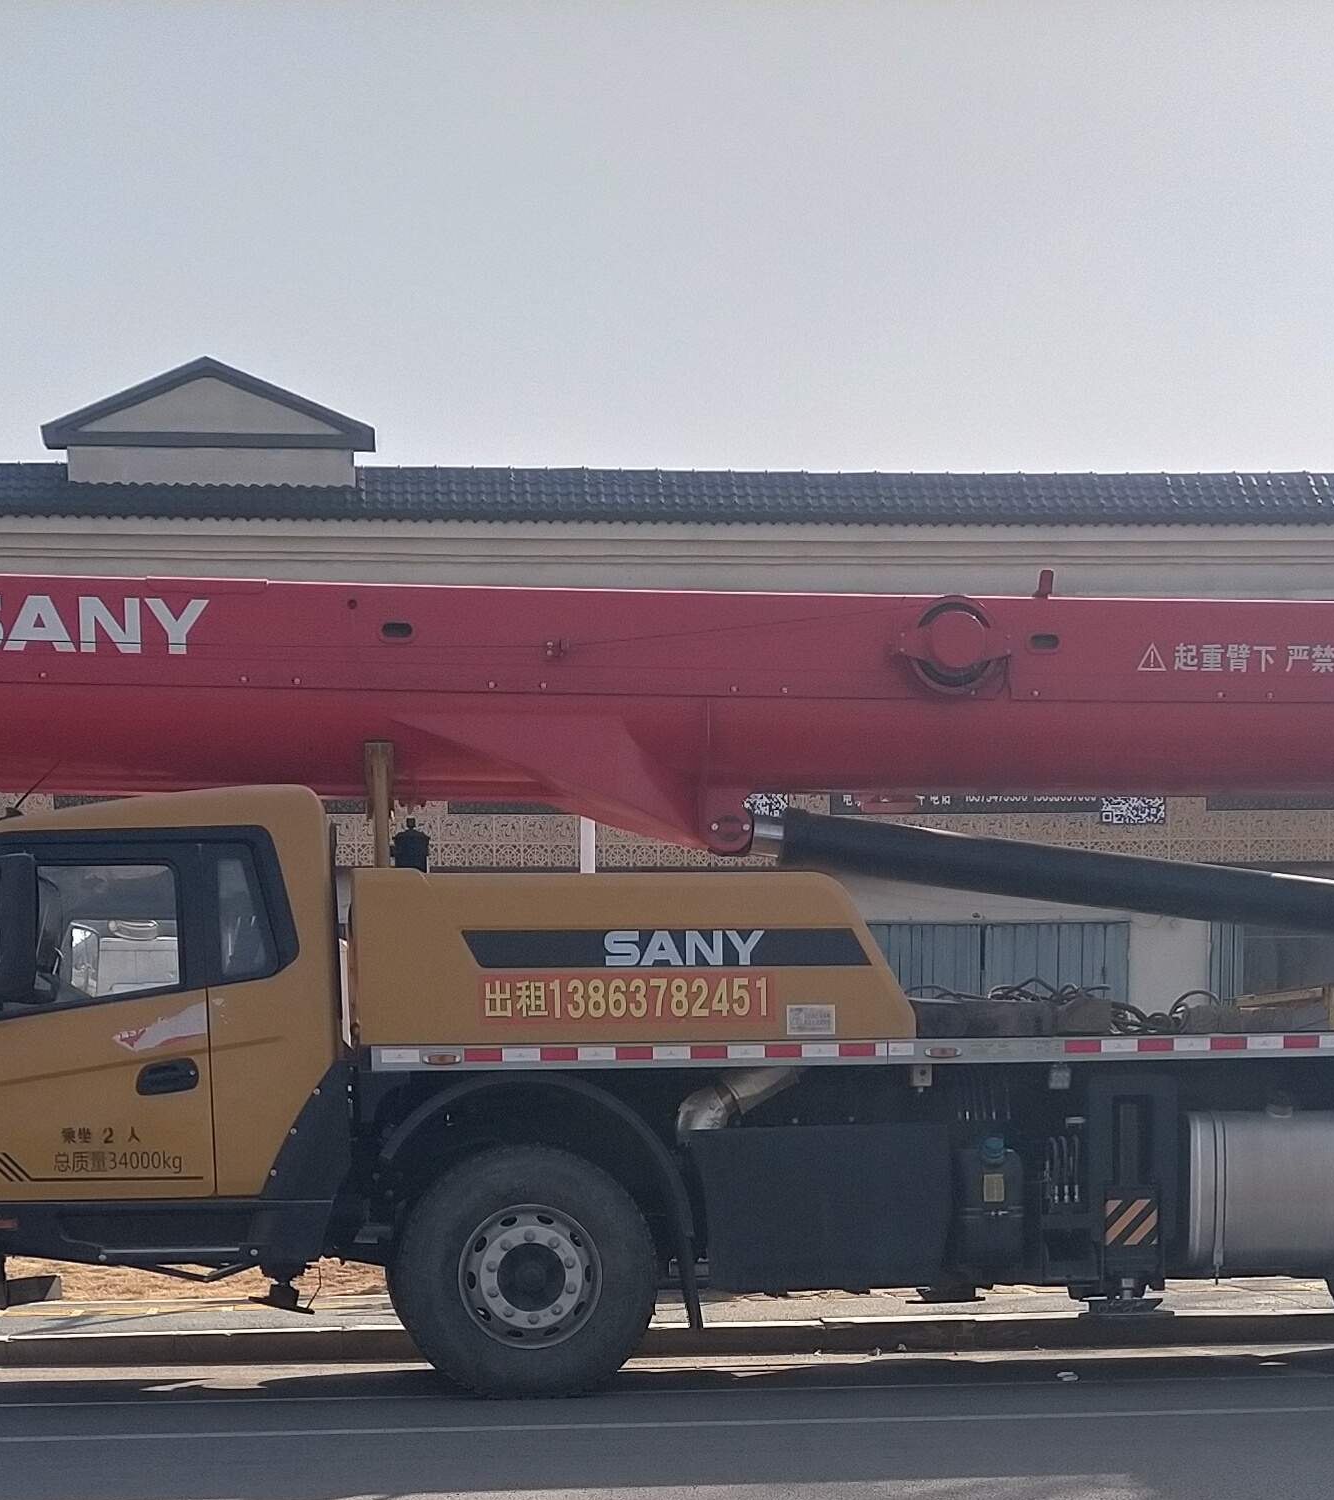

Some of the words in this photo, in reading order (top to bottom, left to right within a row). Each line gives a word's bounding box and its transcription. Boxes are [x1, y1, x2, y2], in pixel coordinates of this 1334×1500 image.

[1173, 642, 1277, 673] 起重臂下
[604, 929, 765, 966] SANY
[484, 976, 768, 1020] 出租13863782451
[103, 1127, 114, 1144] 2
[127, 1126, 141, 1143] 人
[54, 1151, 182, 1173] 总质量34000kg
